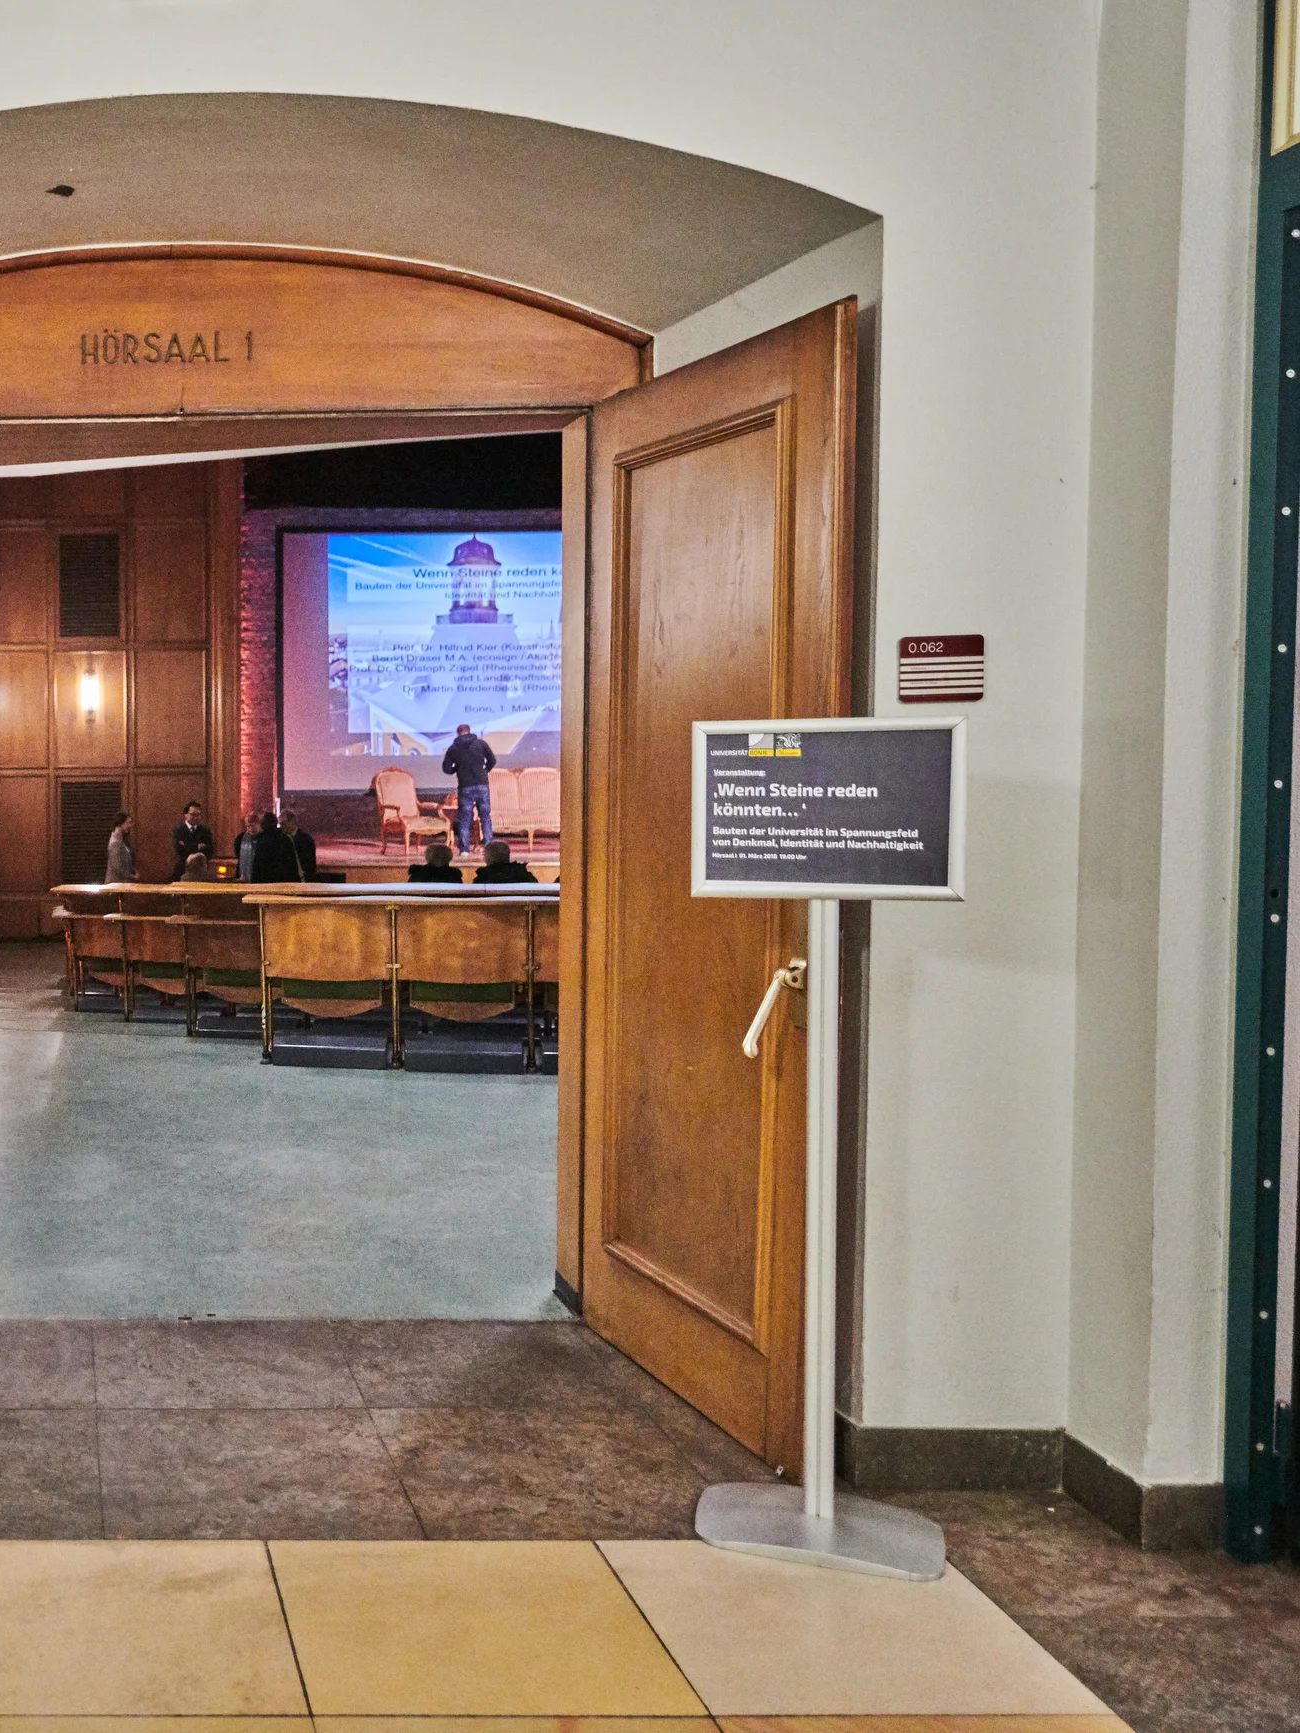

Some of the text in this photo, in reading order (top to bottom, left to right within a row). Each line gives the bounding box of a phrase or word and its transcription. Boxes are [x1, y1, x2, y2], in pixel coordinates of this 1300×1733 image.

[81, 328, 230, 365] HÖRSAAL
[412, 568, 453, 579] Wenn
[458, 568, 502, 578] Steine
[506, 567, 547, 577] reden
[354, 582, 392, 591] Bauten
[396, 581, 413, 590] der
[474, 582, 488, 590] im
[908, 641, 944, 654] 0.062
[713, 768, 766, 777] Veranstaltung:
[769, 783, 823, 797] Steine
[827, 783, 879, 797] reden
[712, 826, 919, 839] Bauten der Universität im Spannungsfeld
[712, 838, 925, 851] von Denkmal, Identität und Nachhaltigkeit
